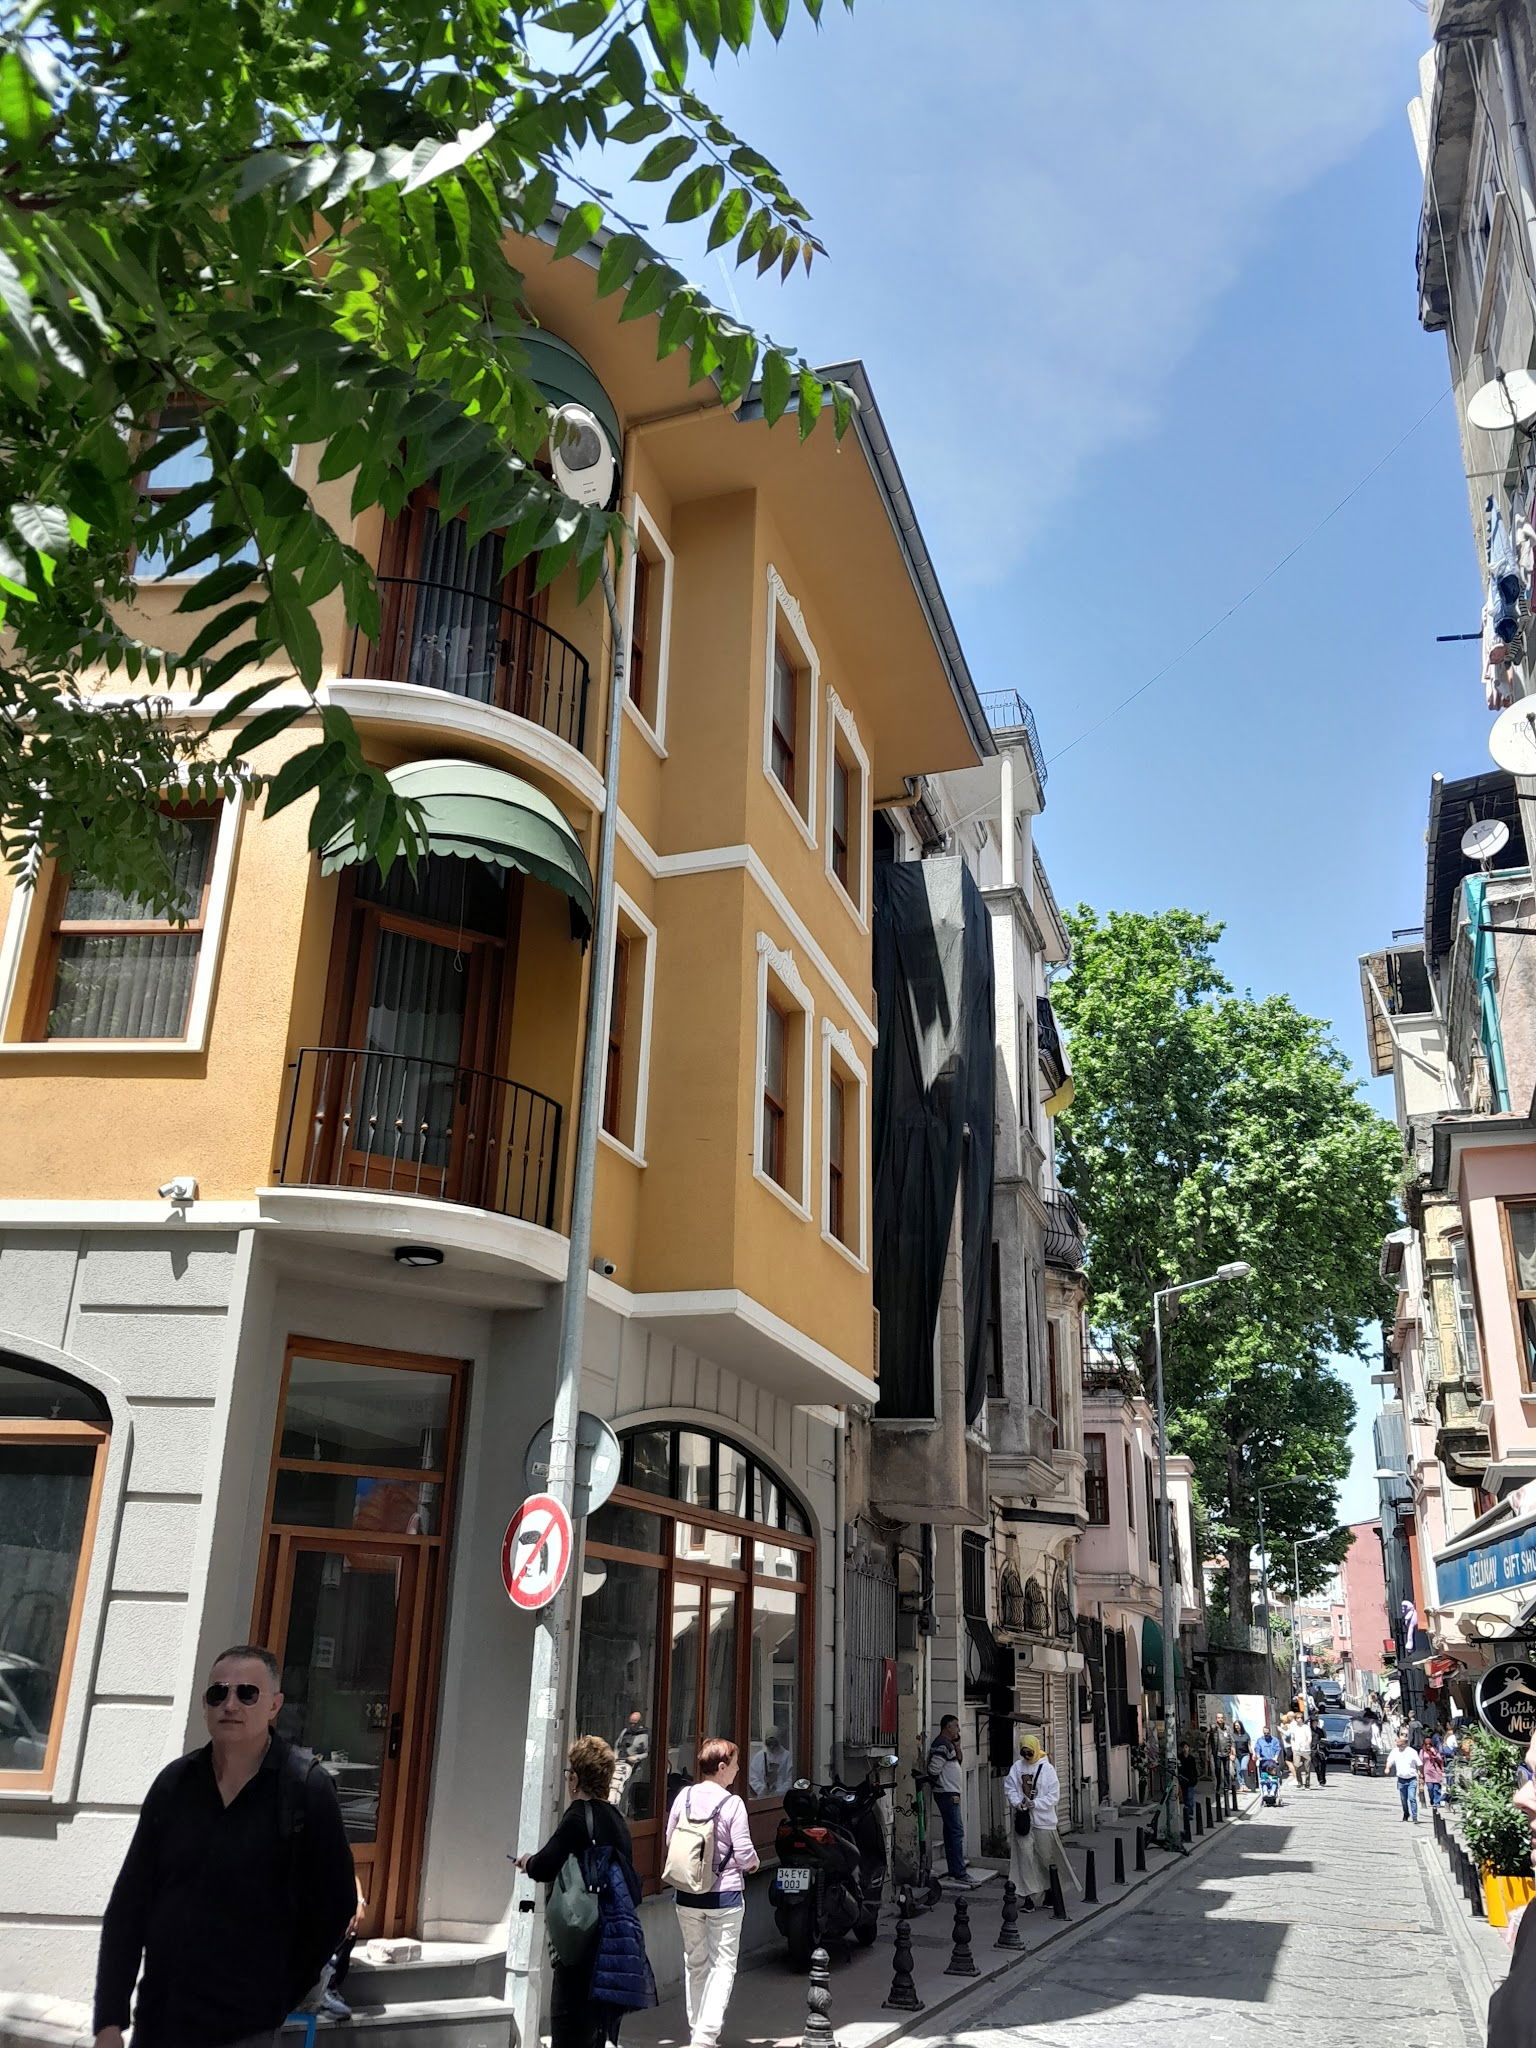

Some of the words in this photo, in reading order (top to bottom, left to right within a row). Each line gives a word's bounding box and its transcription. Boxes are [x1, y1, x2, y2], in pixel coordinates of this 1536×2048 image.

[1503, 1552, 1520, 1579] GIFT
[779, 1869, 789, 1878] 34
[791, 1869, 808, 1879] EYE
[784, 1880, 800, 1889] 003
